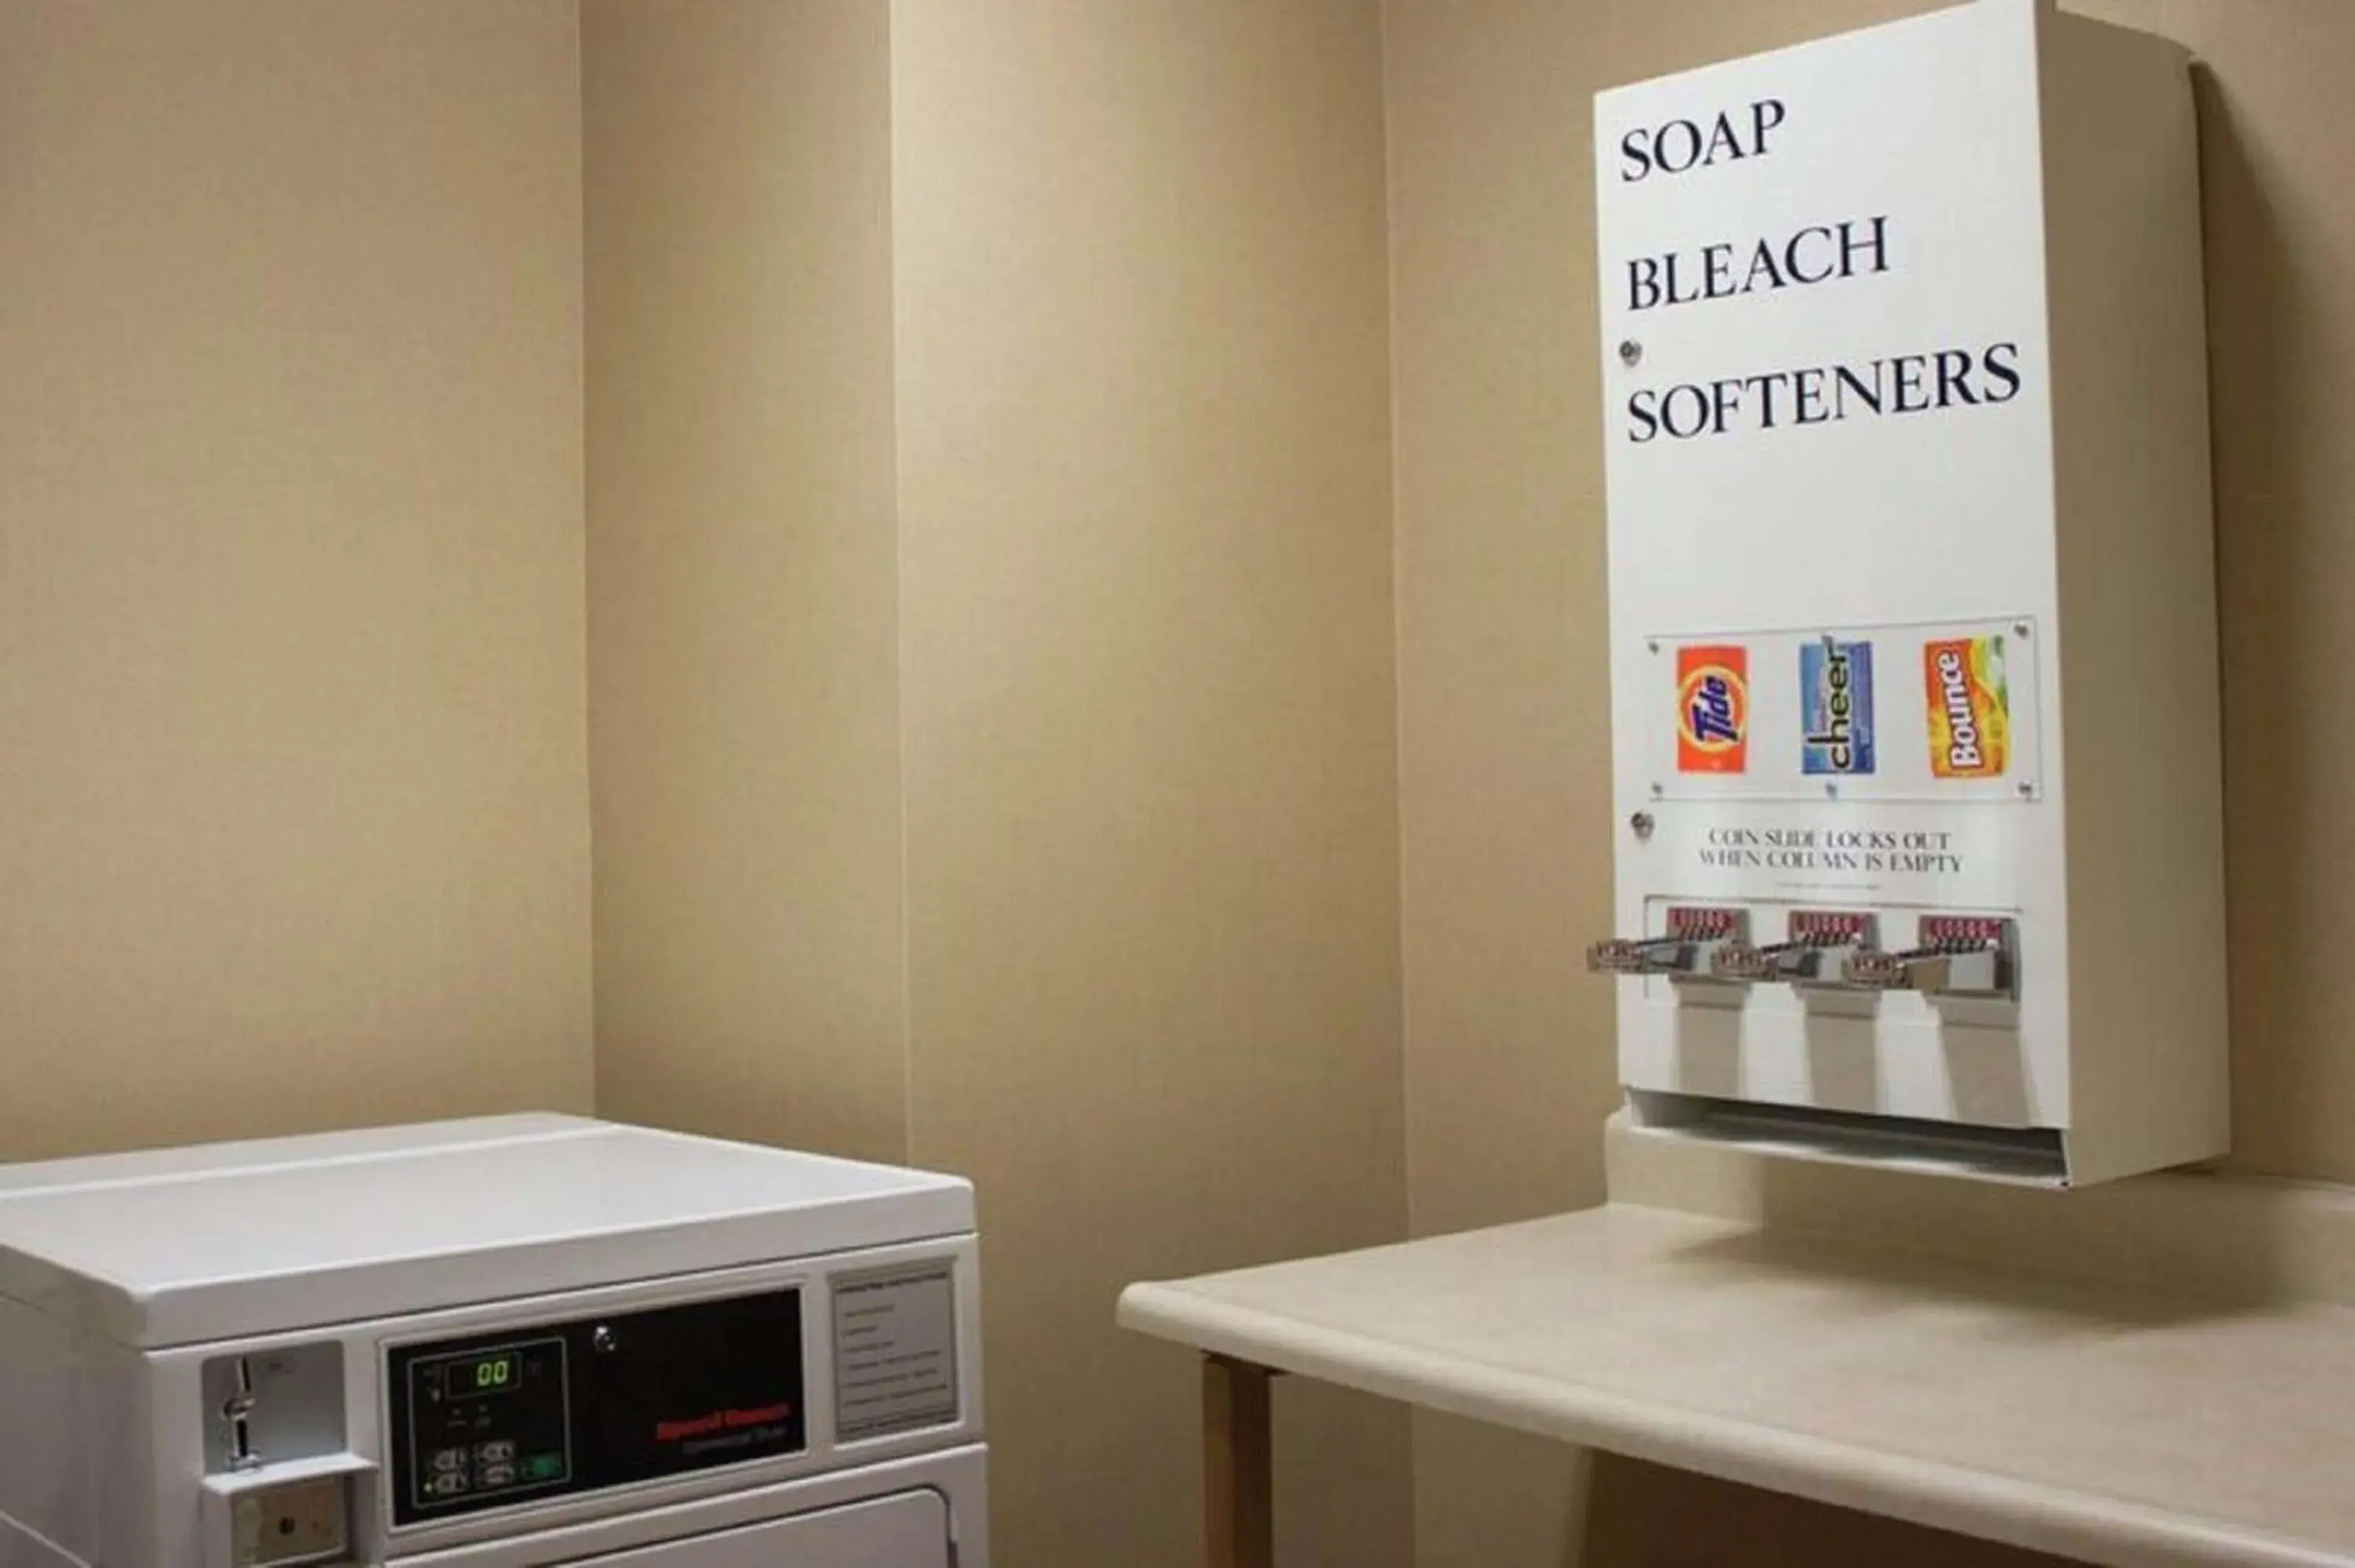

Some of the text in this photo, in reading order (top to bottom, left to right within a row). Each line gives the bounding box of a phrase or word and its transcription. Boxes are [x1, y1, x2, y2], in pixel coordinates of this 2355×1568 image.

[1620, 98, 1786, 183] SOAP
[1627, 217, 1889, 311] BLEACH
[1627, 343, 2021, 443] SOFTENERS
[1692, 675, 1738, 742] Tide
[1807, 635, 1850, 769] cheer
[1937, 650, 1983, 768] Bounce
[1699, 849, 1963, 873] WHEN COLUMN IS EMPTY
[1708, 828, 1759, 846] COIN
[1826, 830, 1897, 850] LOCKS
[1903, 831, 1952, 851] OUT
[476, 1360, 509, 1387] 00
